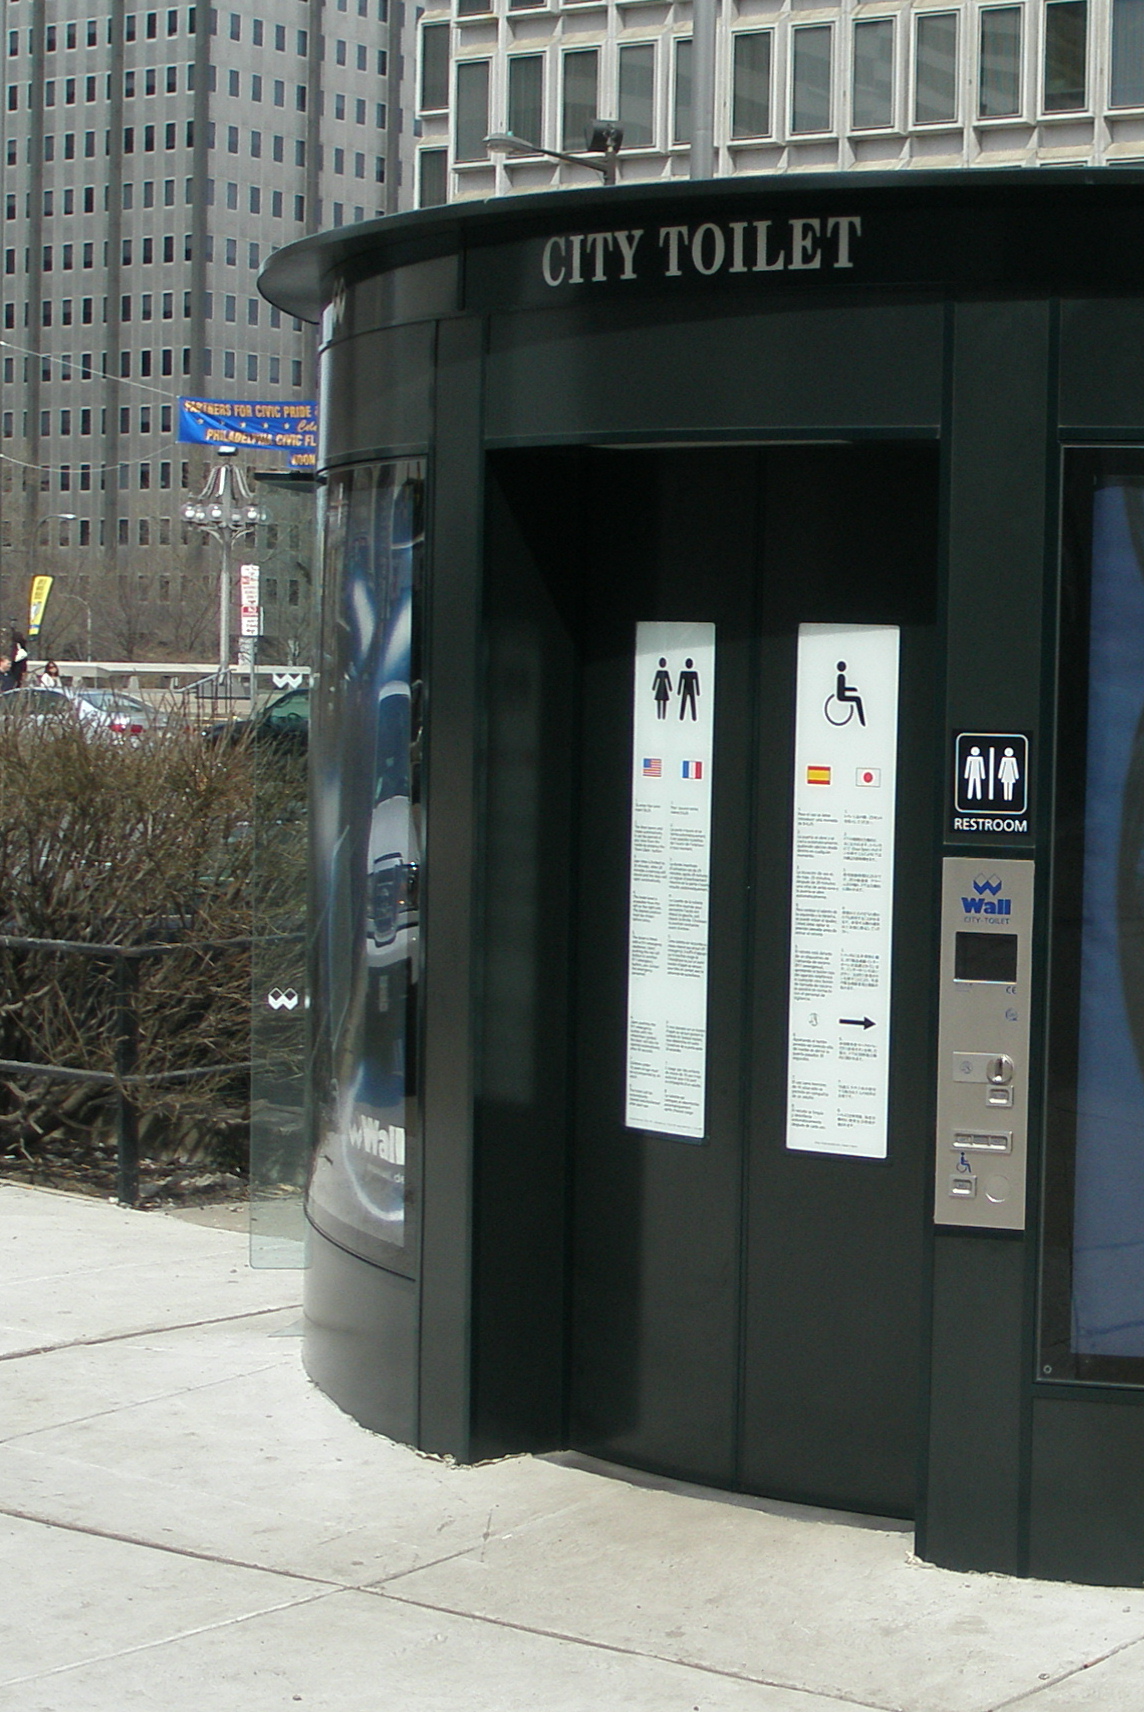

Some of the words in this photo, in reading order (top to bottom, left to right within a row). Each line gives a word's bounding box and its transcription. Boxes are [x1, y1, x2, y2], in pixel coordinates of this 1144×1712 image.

[542, 229, 644, 287] CITY
[659, 216, 862, 277] TOILET
[234, 404, 252, 418] FOR
[255, 404, 281, 418] CIVIC
[284, 405, 312, 418] PRIDE
[276, 433, 303, 447] CIVIC
[954, 818, 1028, 832] RESTROOM
[961, 897, 1012, 915] Wall
[361, 1114, 405, 1166] Wall
